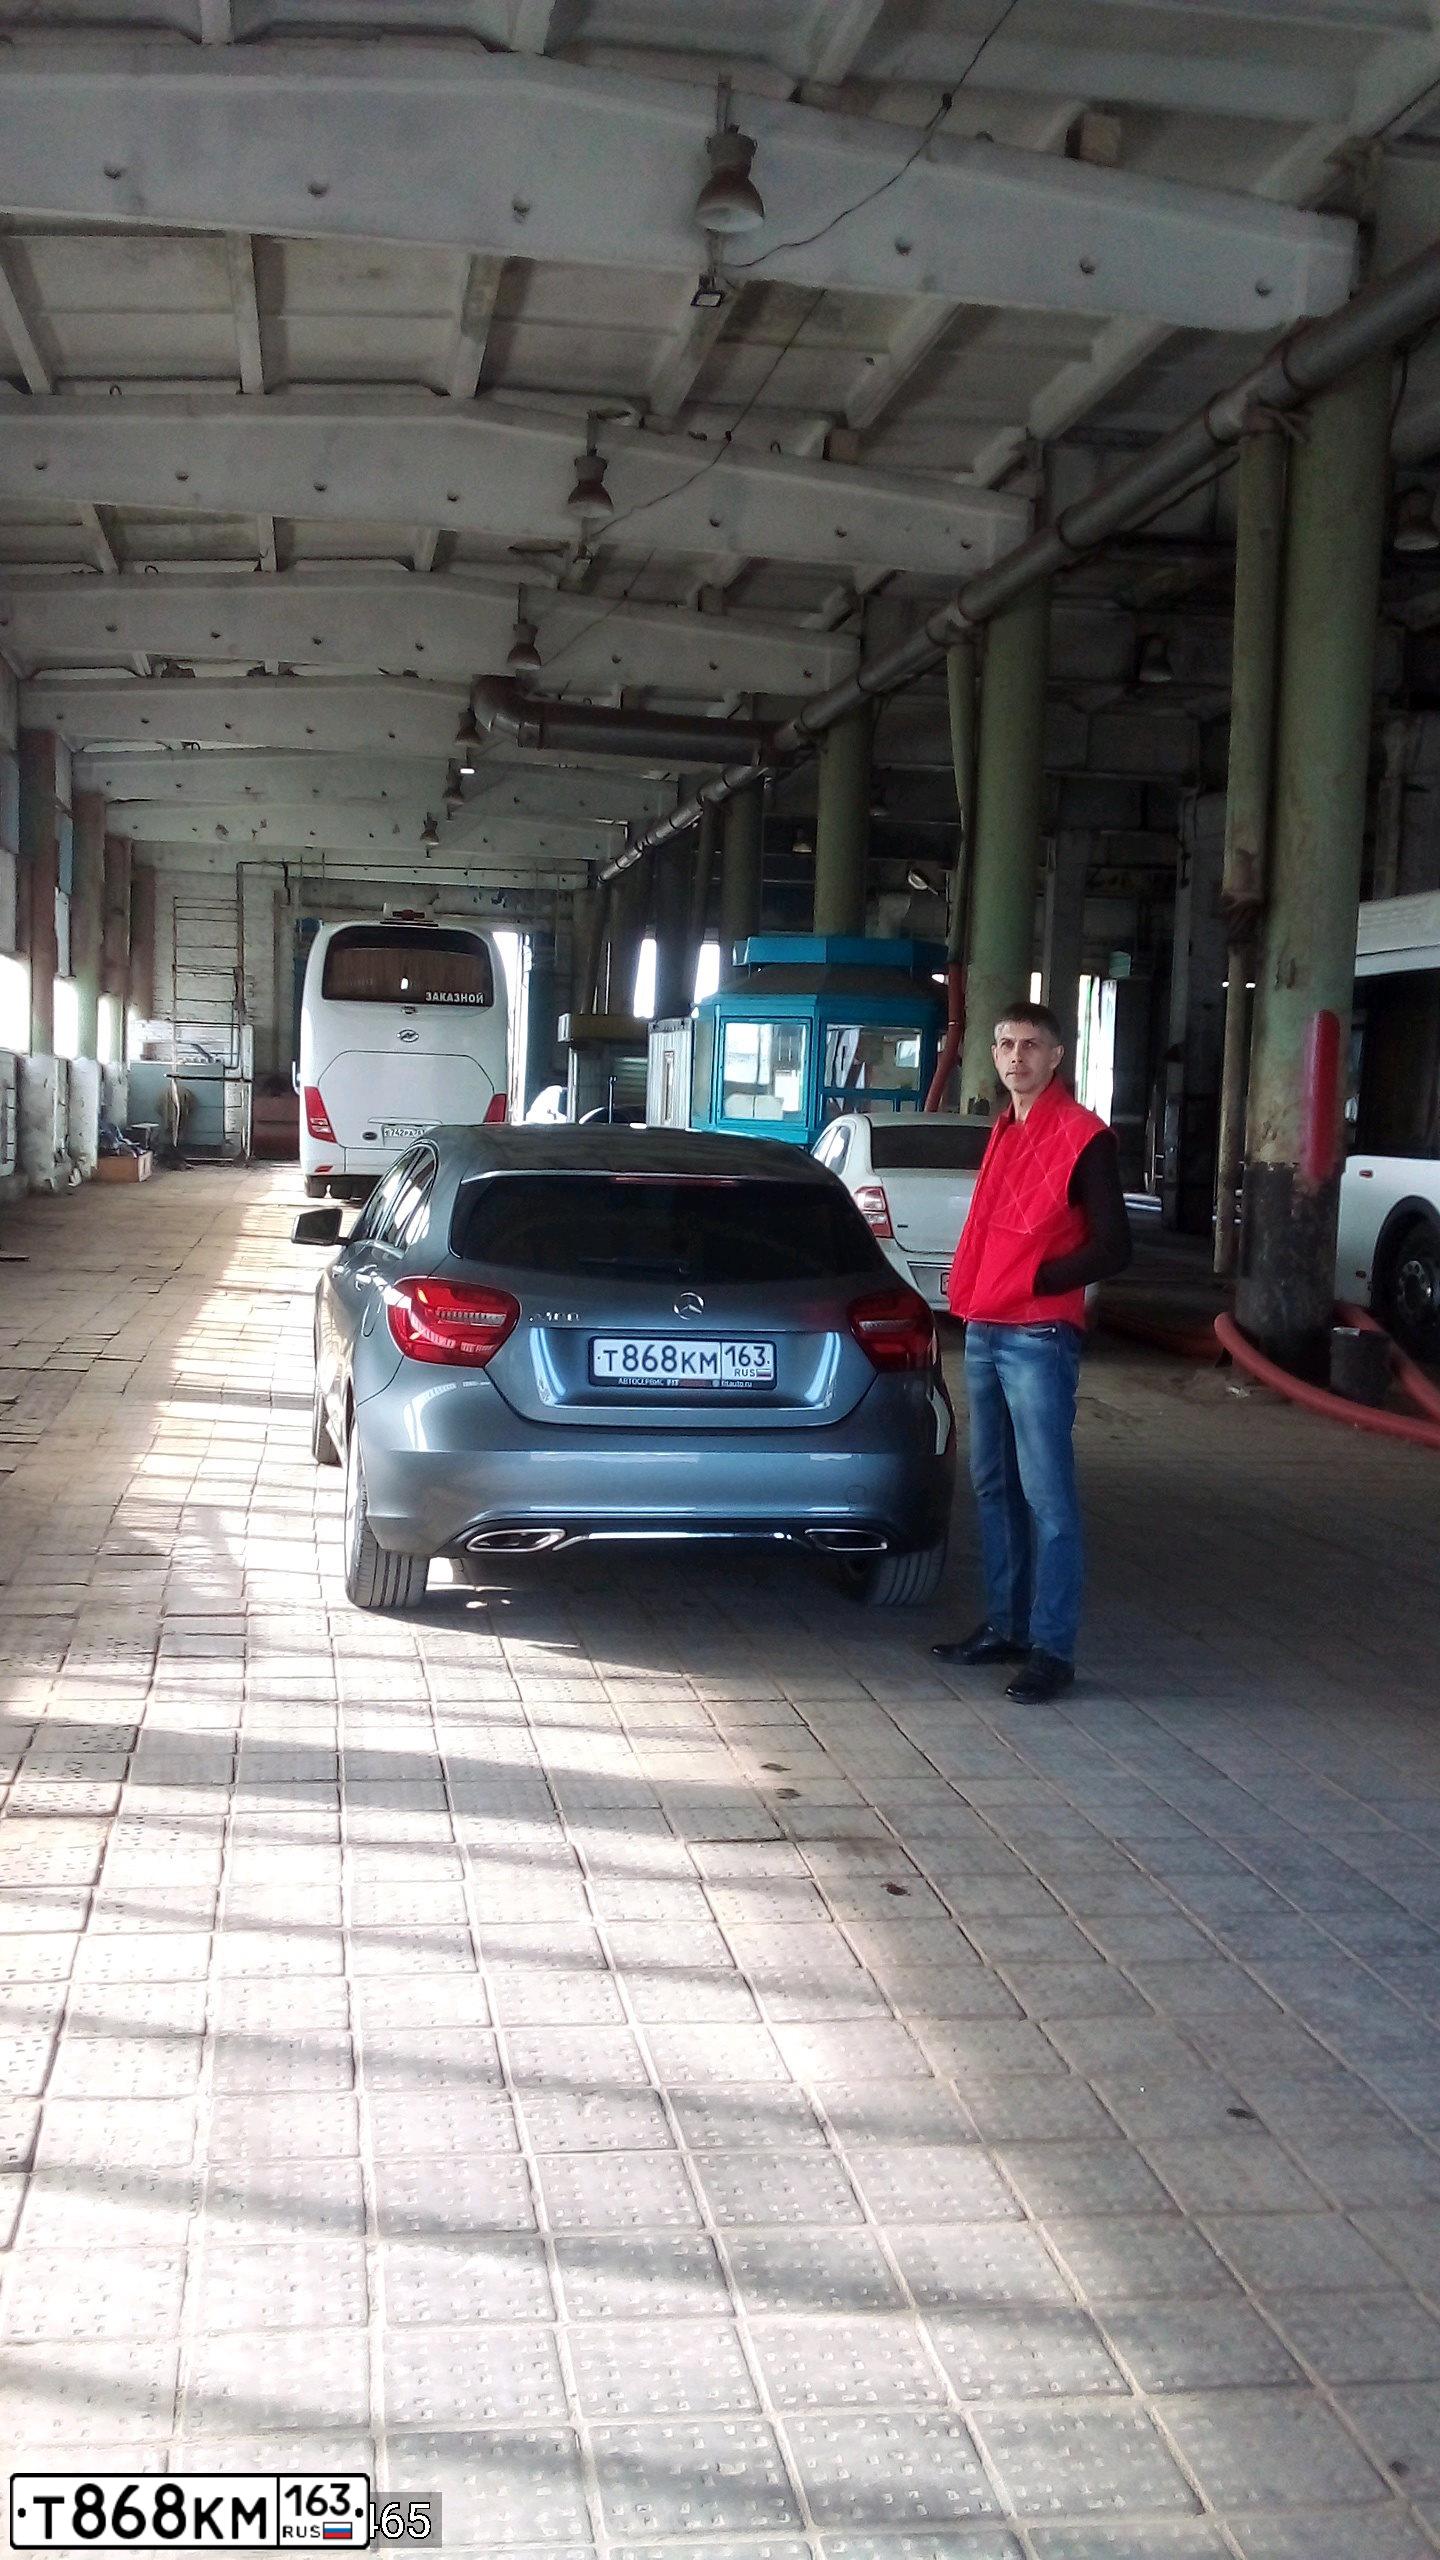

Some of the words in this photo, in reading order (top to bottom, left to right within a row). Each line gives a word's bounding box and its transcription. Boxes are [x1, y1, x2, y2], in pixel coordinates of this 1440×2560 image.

[425, 991, 484, 1004] ЗАКАЗНОЙ
[603, 1344, 718, 1374] Т868КМ
[725, 1346, 766, 1367] 163
[734, 1369, 756, 1377] RUS
